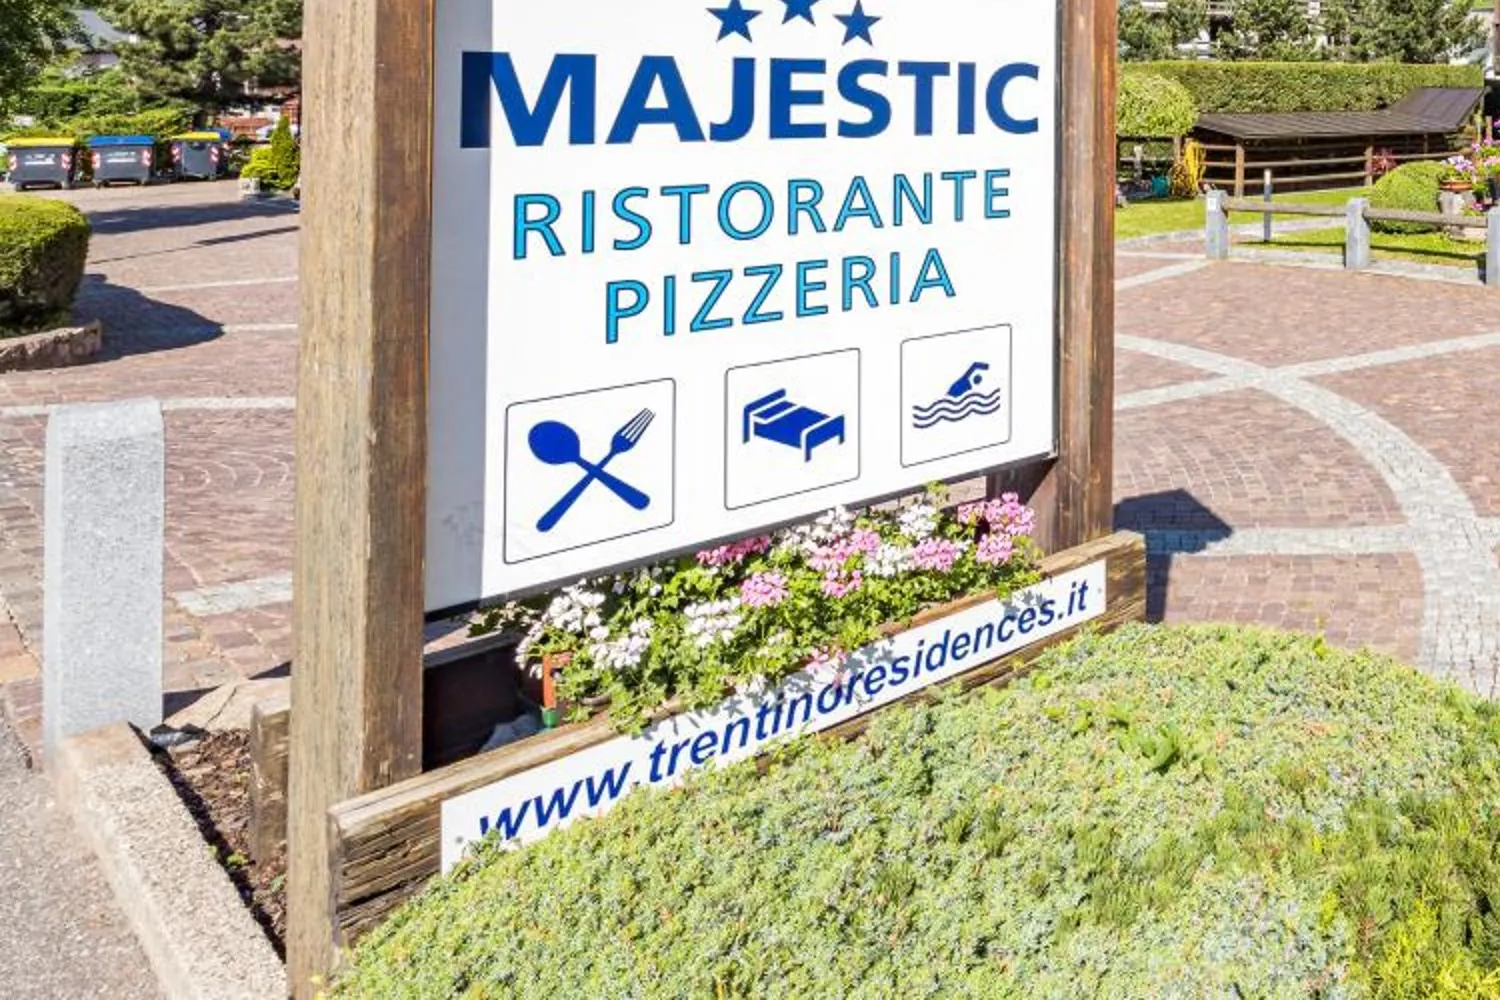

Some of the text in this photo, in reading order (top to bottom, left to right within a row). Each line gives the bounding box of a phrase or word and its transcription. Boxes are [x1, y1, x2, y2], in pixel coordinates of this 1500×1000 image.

[460, 50, 1040, 148] MAJESTIC
[512, 168, 1011, 260] RISTORANTE
[604, 247, 956, 344] PIZZERIA
